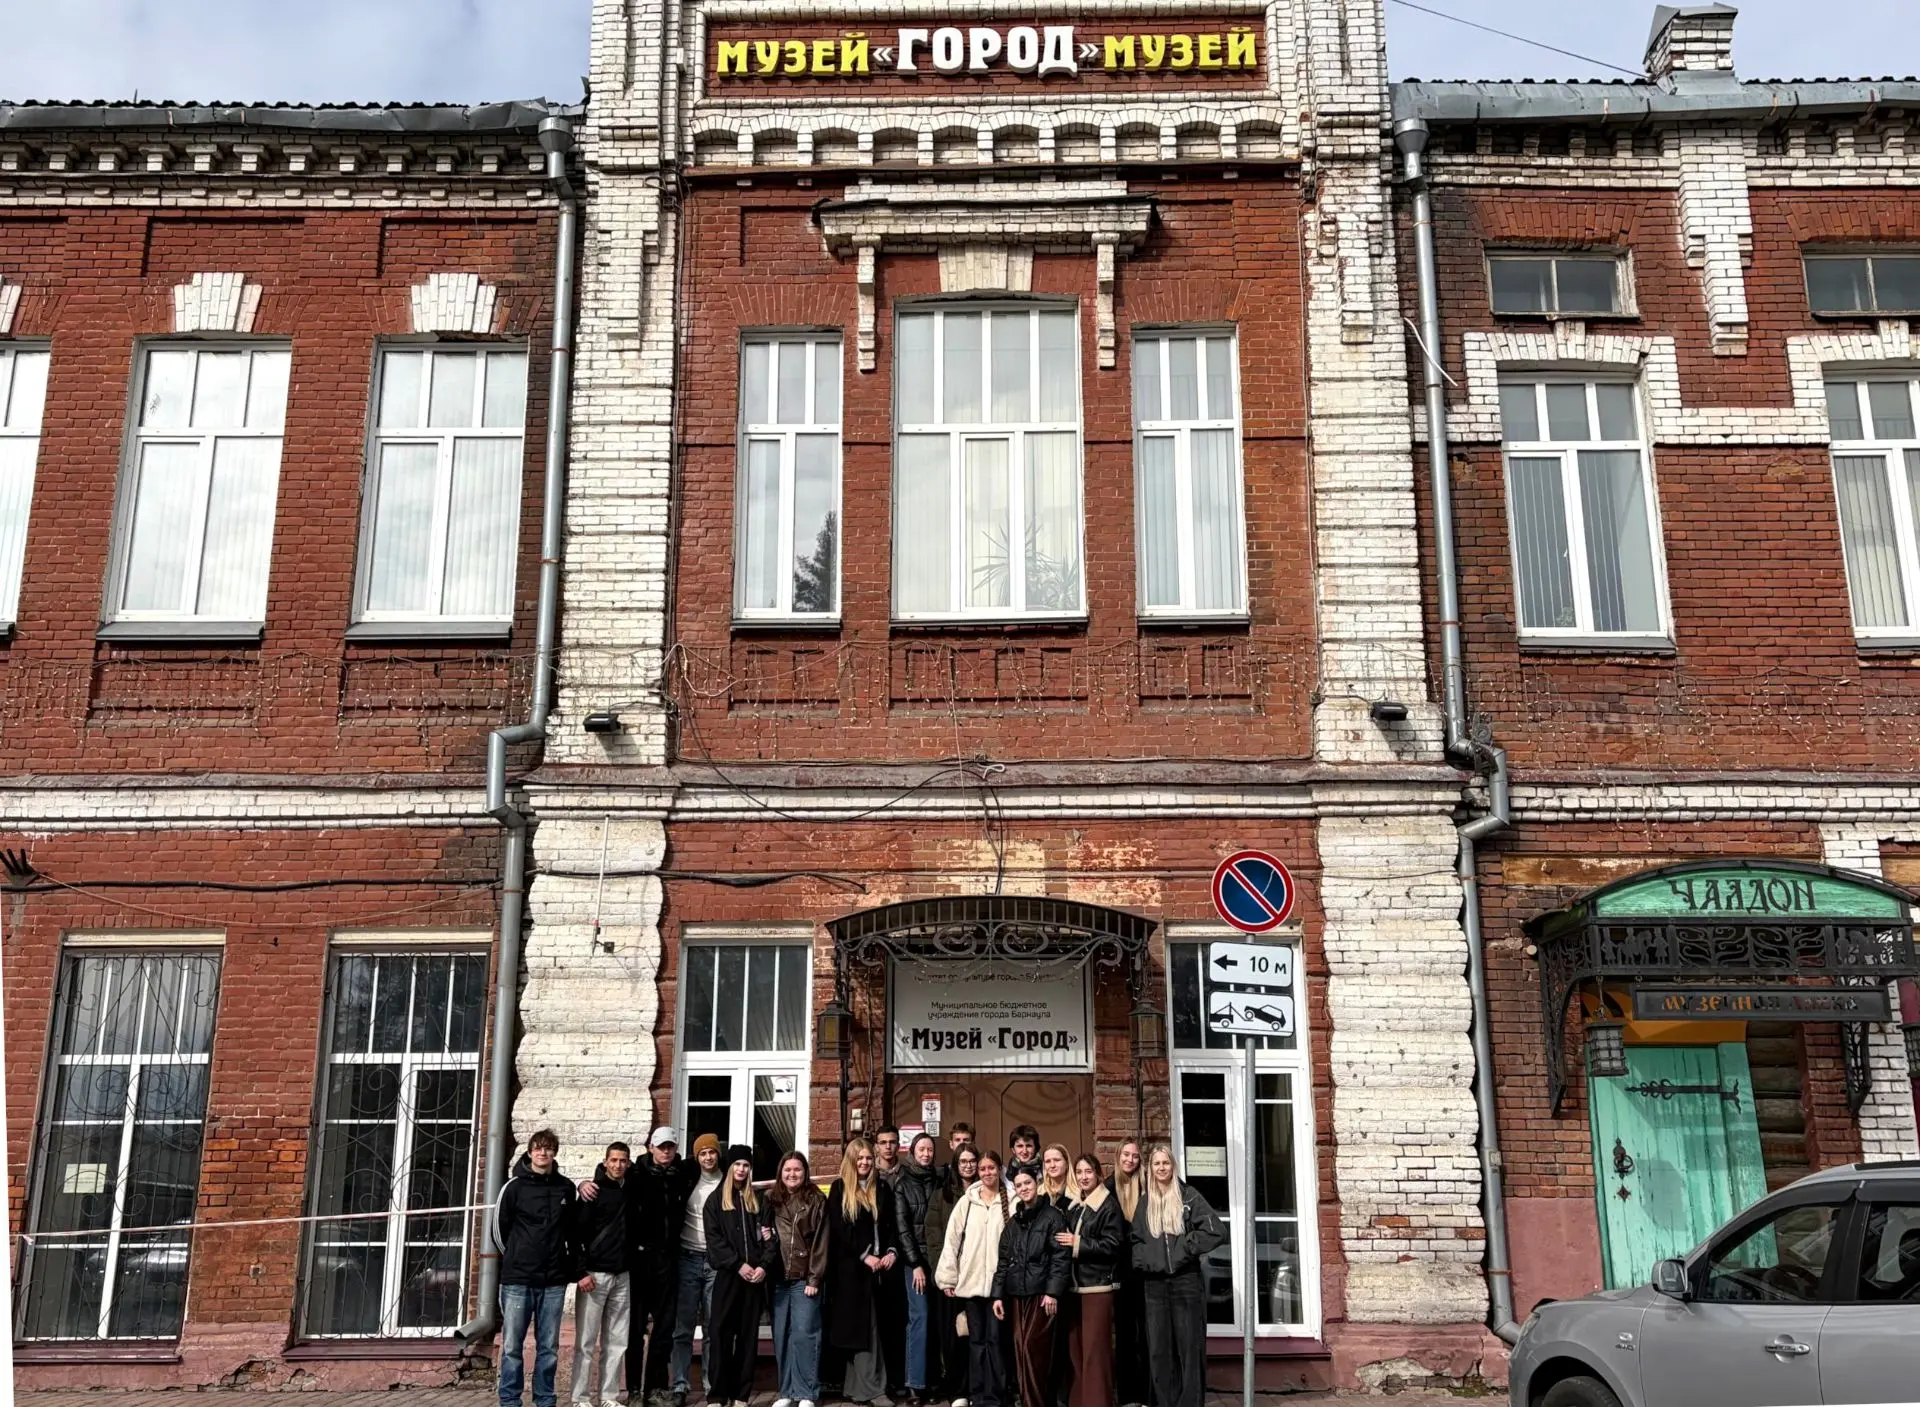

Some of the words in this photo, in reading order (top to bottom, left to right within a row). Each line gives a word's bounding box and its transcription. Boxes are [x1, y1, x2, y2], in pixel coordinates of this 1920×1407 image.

[717, 32, 870, 76] МУЗЕЙ
[872, 26, 1099, 79] «ГОРОД»
[1103, 27, 1258, 72] МУЗЕЙ
[1668, 878, 1816, 914] ЧАЛДОН
[1249, 956, 1269, 973] 10
[931, 1001, 998, 1011] Муниципальное
[999, 1001, 1048, 1010] бюджетное
[981, 1010, 1010, 1019] города
[1011, 1010, 1051, 1020] Барнаула
[901, 1027, 983, 1052] «Музей
[987, 1027, 1078, 1052] «Город»
